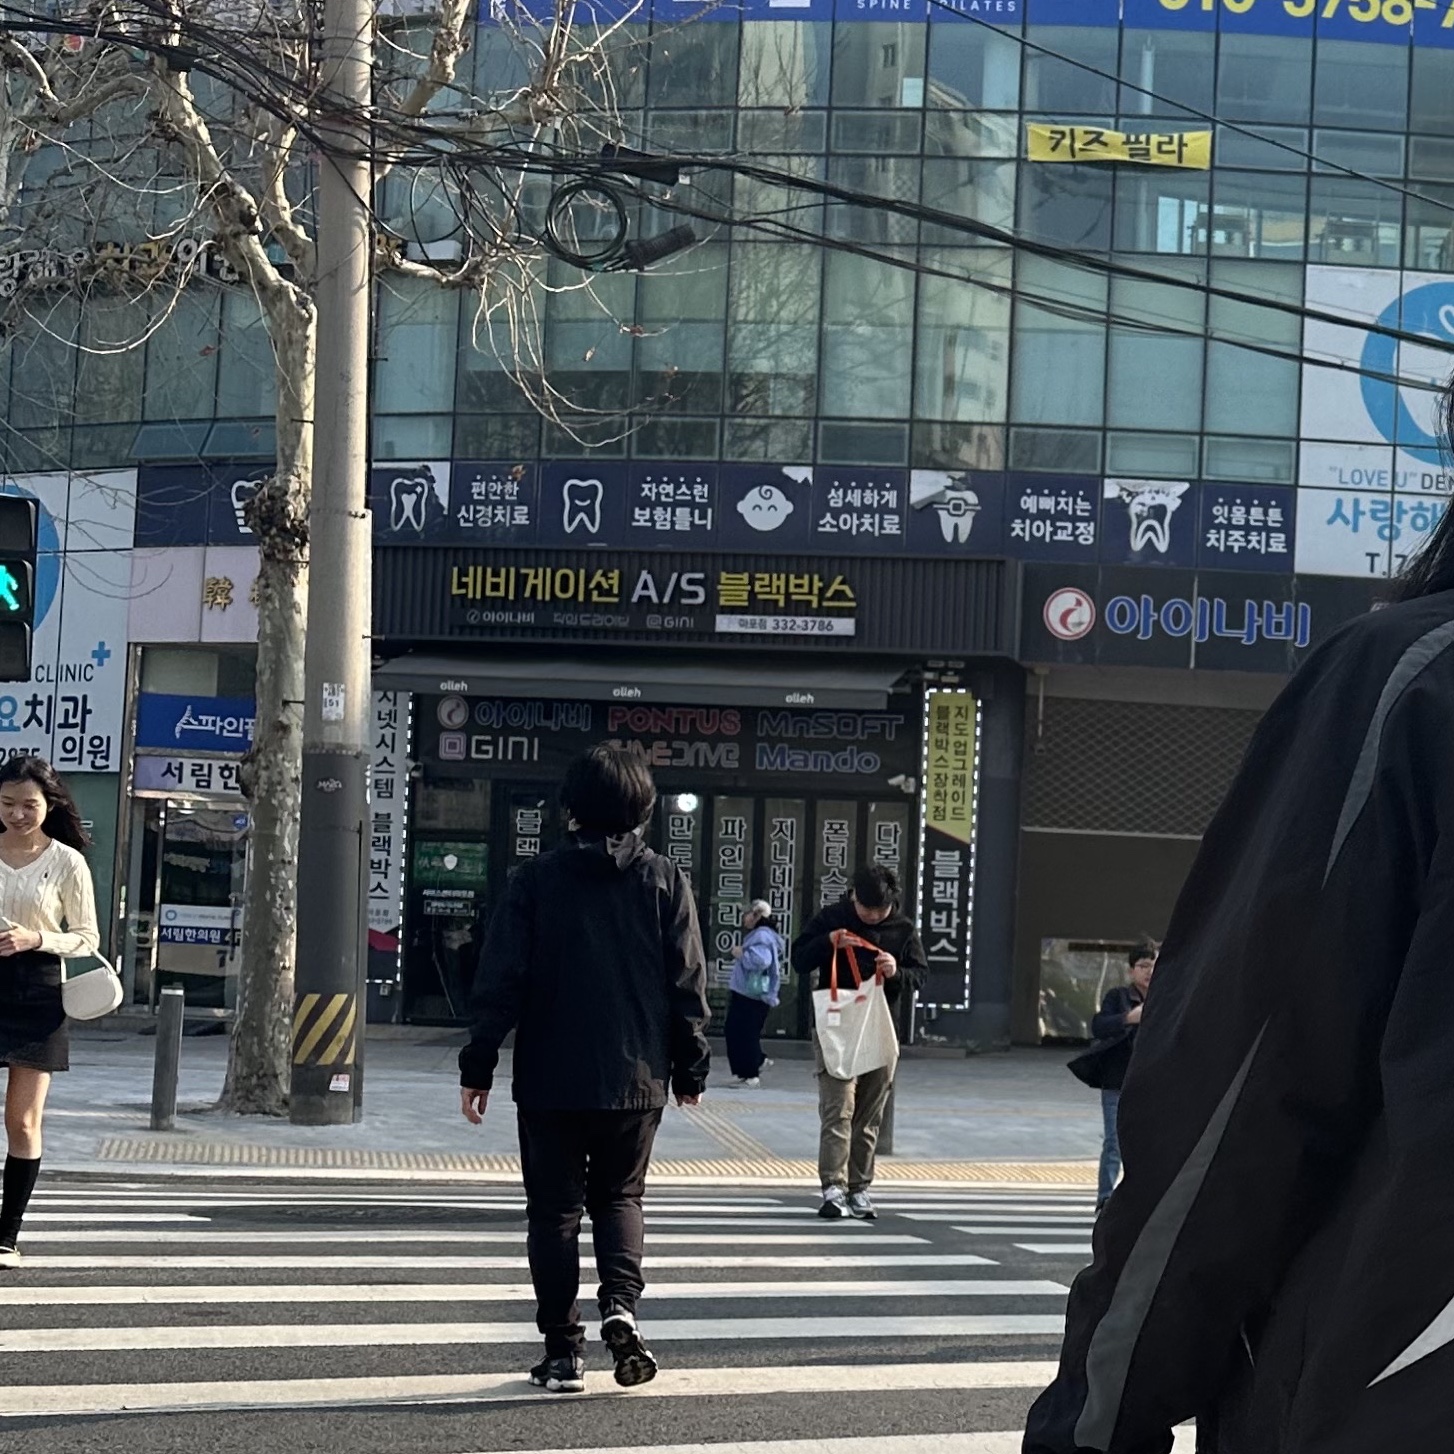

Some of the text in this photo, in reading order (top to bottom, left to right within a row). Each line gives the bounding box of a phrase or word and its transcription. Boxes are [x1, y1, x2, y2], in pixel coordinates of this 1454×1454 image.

[857, 0, 911, 10] SPINE
[1048, 128, 1109, 160] 키즈
[471, 479, 520, 501] 편안한
[640, 482, 709, 503] 자연스런
[827, 487, 898, 509] 섬세하게
[457, 505, 531, 528] 신경치료
[1020, 494, 1092, 517] 예뻐지는
[1212, 503, 1284, 528] 잇몸튼튼
[631, 506, 713, 531] 보험틀니
[817, 512, 902, 537] 소아치료
[1010, 518, 1095, 545] 치아교정
[1206, 528, 1288, 554] 치주치료
[450, 565, 857, 609] 네비게이션 A/S 블랙박스
[482, 611, 535, 625] 아이나비
[772, 618, 835, 632] 332-3786
[1105, 594, 1312, 649] 아이나비
[34, 663, 95, 683] CLINIC
[440, 680, 468, 692] olleh
[613, 686, 641, 699] olleh
[785, 692, 814, 705] olleh
[474, 700, 592, 732] 아이나비
[607, 703, 742, 736] PONTUS
[756, 711, 904, 741] MnSOFT
[59, 735, 111, 770] 의원
[470, 732, 539, 762] GINI
[755, 743, 881, 773] Mando
[368, 812, 394, 900] 블랙박스
[926, 849, 964, 963] 블랙박스
[160, 927, 221, 944] 서림한의원
